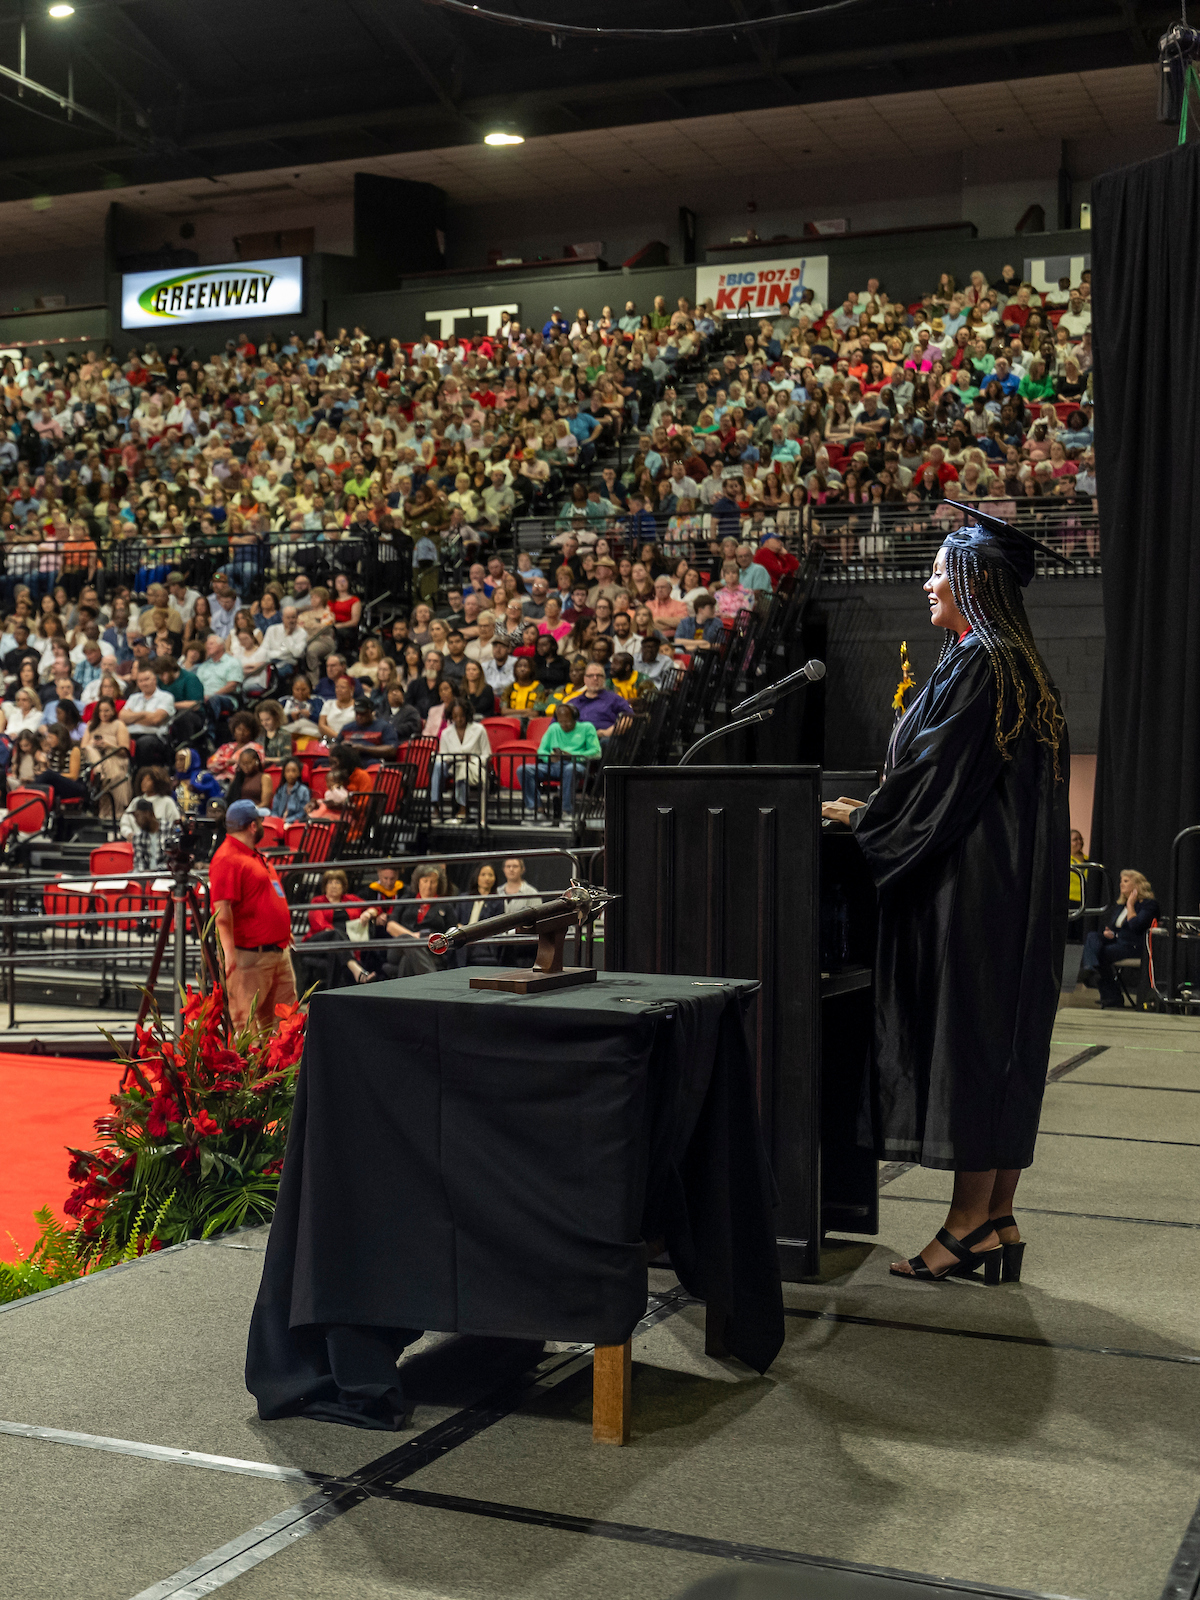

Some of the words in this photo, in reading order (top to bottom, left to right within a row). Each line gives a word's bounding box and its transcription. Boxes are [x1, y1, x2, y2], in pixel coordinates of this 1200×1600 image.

[726, 271, 756, 286] BIG
[757, 268, 801, 283] 107.9
[155, 275, 275, 312] GREENWAY
[715, 283, 792, 310] KFIN
[425, 303, 518, 340] TT
